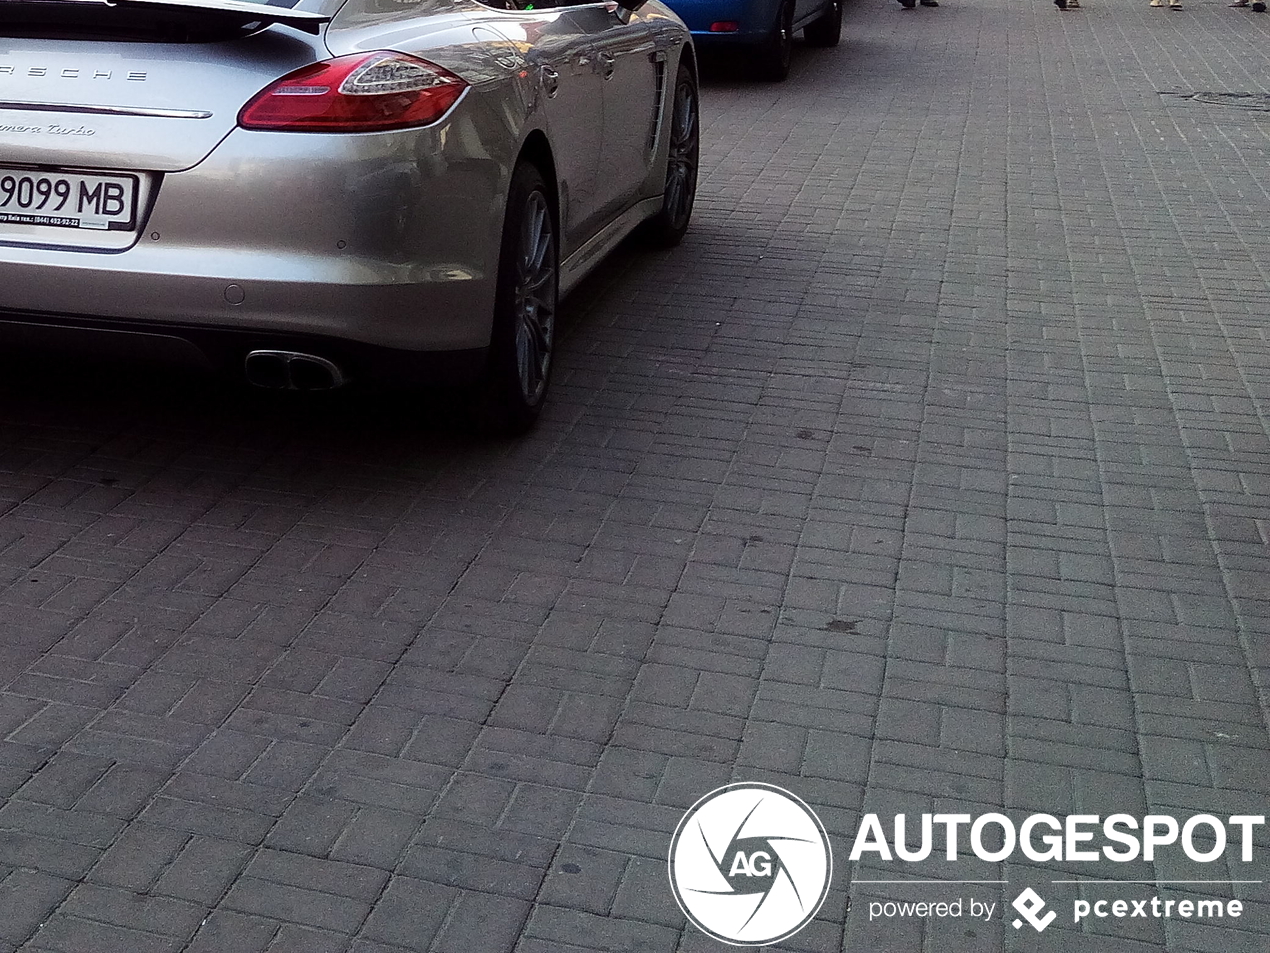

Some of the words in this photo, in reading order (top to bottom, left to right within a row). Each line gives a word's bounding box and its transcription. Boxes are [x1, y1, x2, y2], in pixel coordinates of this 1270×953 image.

[47, 124, 96, 136] Turbo
[0, 175, 71, 212] 9099
[77, 179, 125, 216] MB
